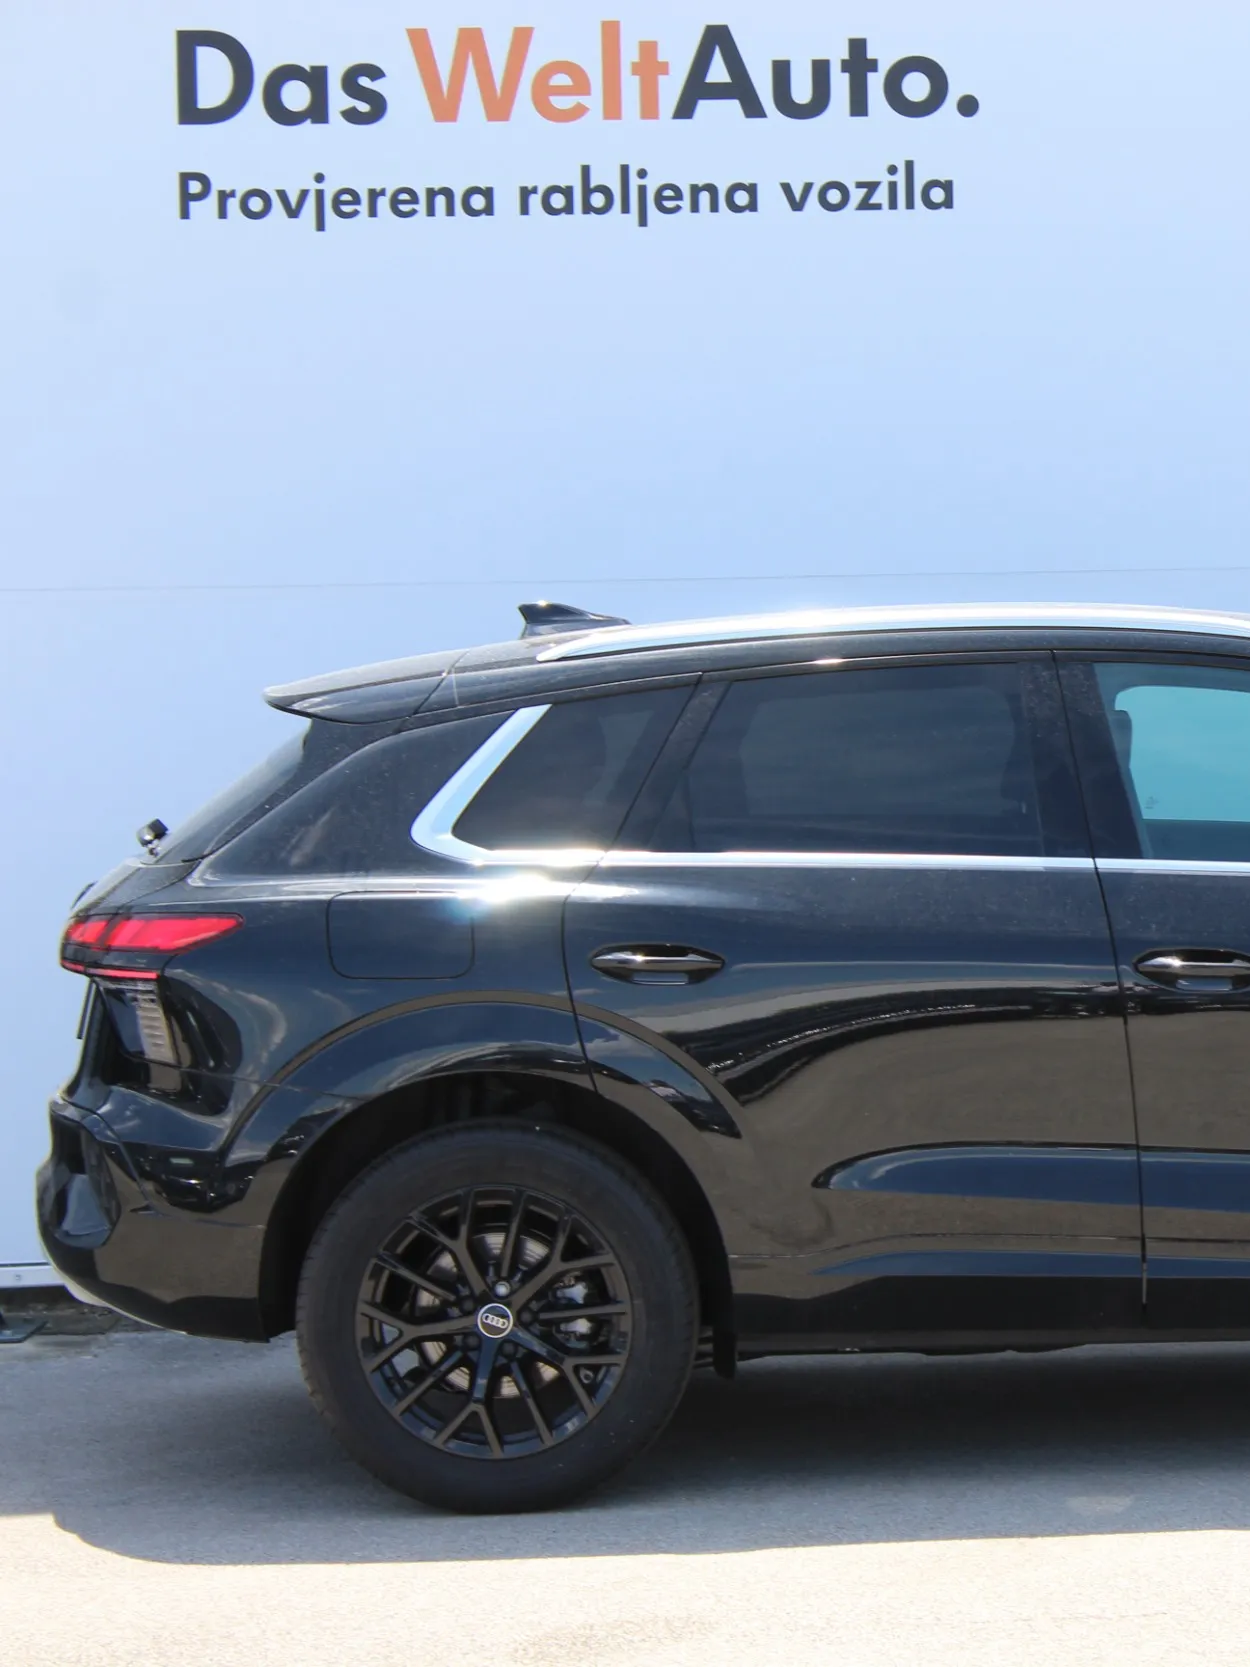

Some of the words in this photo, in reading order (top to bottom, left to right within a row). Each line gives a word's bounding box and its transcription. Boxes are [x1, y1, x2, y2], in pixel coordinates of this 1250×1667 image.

[177, 27, 386, 126] Das
[407, 20, 979, 121] WeltAuto.
[179, 171, 493, 232] Provjerena
[519, 164, 758, 227] rabljena
[780, 159, 953, 212] vozila
